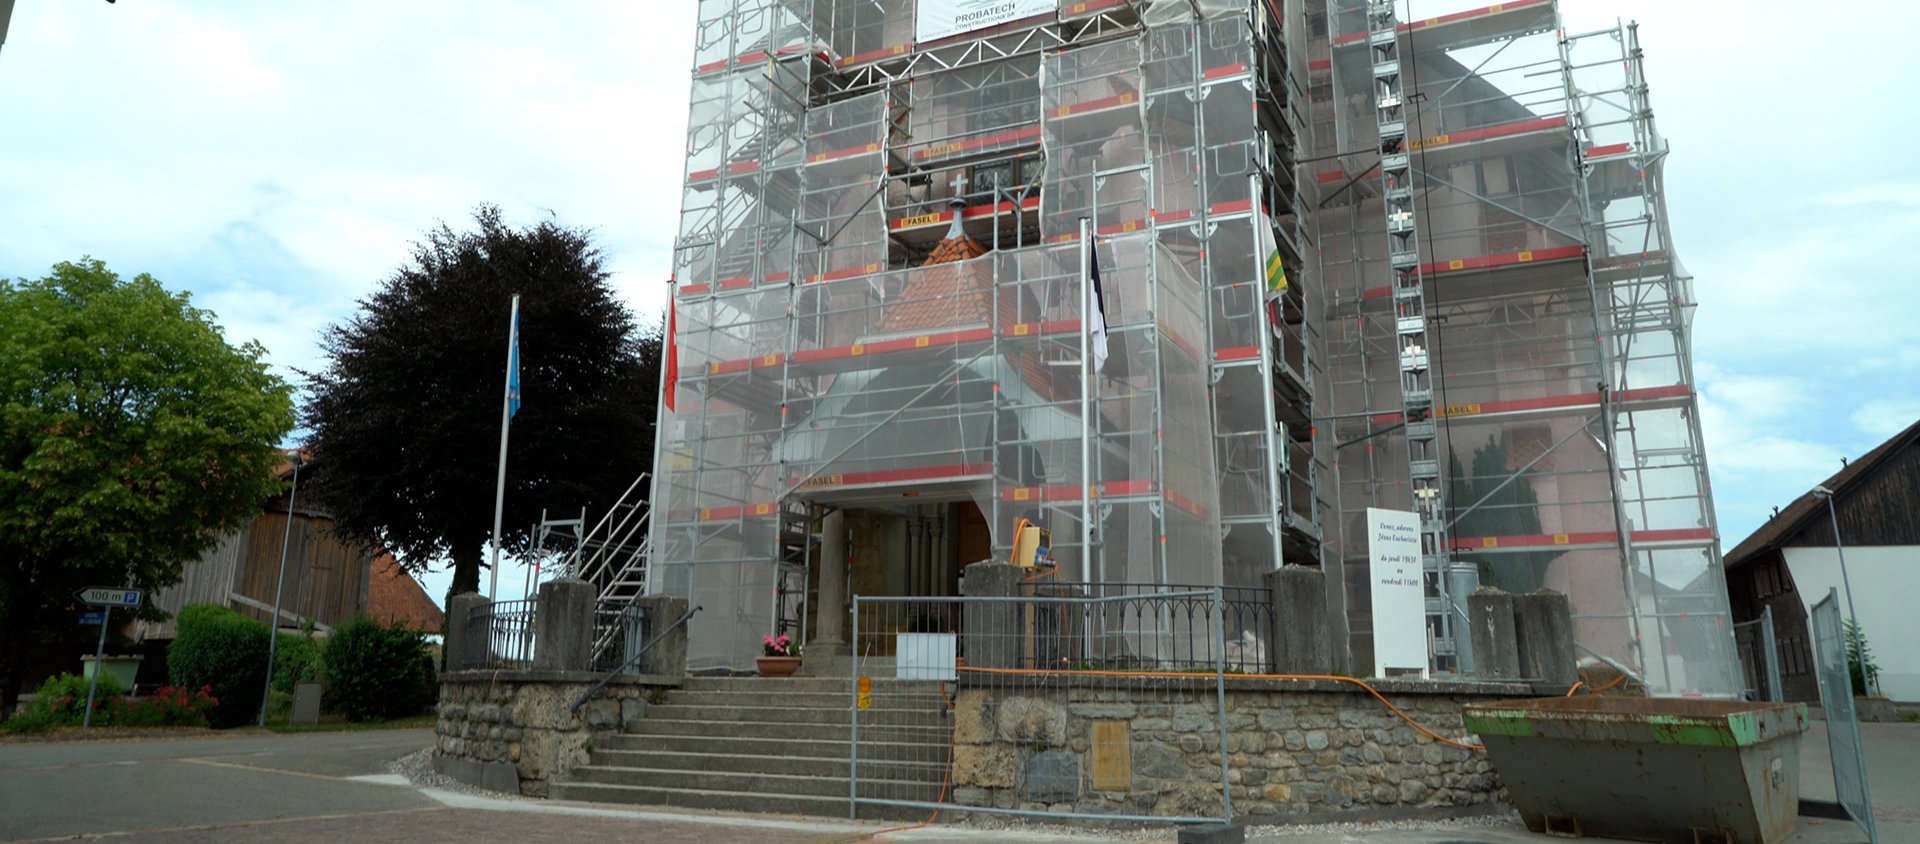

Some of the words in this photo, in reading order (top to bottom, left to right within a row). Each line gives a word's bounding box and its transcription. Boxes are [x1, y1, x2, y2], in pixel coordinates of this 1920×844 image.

[955, 2, 1016, 24] PROBATECH
[955, 14, 1006, 31] CONSTRUCTIONS
[1412, 137, 1439, 148] FASEL
[931, 145, 954, 155] FASEL
[908, 216, 932, 226] FASEL
[807, 476, 835, 486] FASEL
[1380, 554, 1388, 562] du
[1387, 555, 1400, 564] jeudi
[1381, 577, 1402, 586] vendredi
[91, 591, 109, 600] 100
